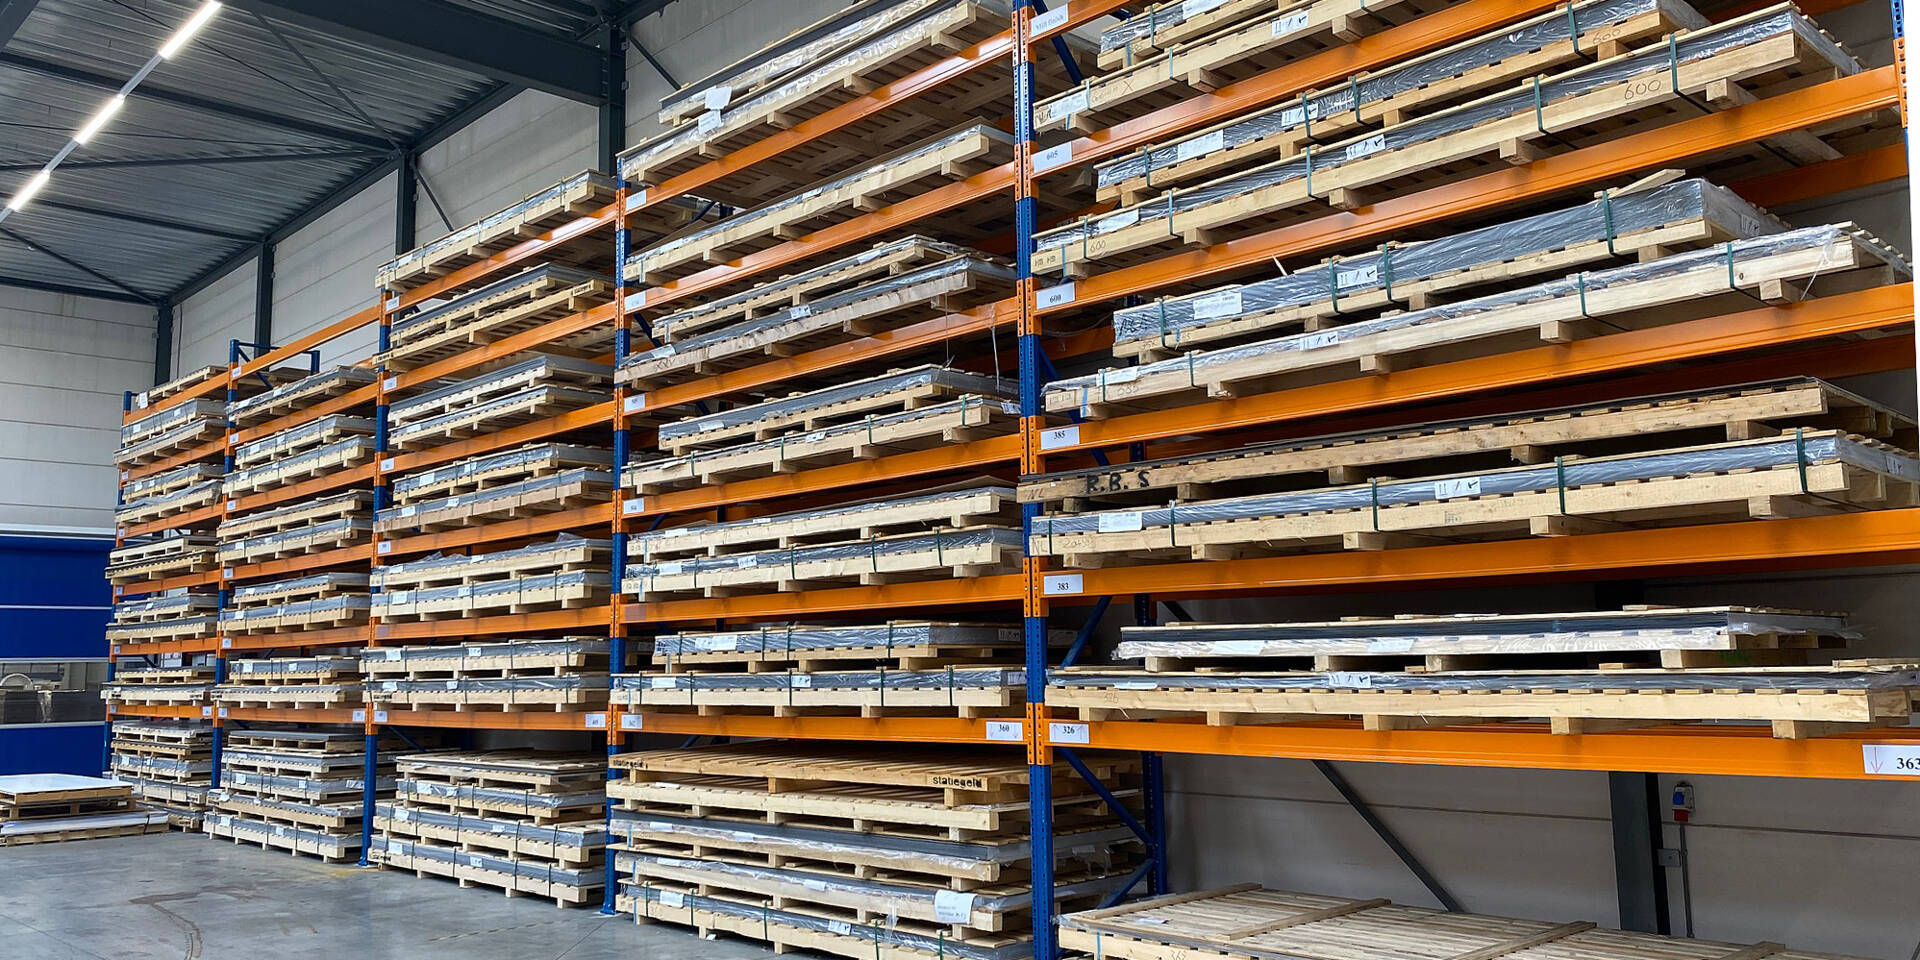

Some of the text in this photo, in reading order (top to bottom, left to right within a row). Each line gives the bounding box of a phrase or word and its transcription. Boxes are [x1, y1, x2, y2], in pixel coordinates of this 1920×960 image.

[1592, 28, 1621, 45] 600
[1624, 79, 1662, 100] 600
[1053, 430, 1066, 440] 385
[1031, 537, 1048, 553] NL
[1057, 582, 1069, 591] 383
[998, 724, 1010, 732] 360
[1062, 726, 1075, 735] 326
[932, 776, 982, 789] statiegeld
